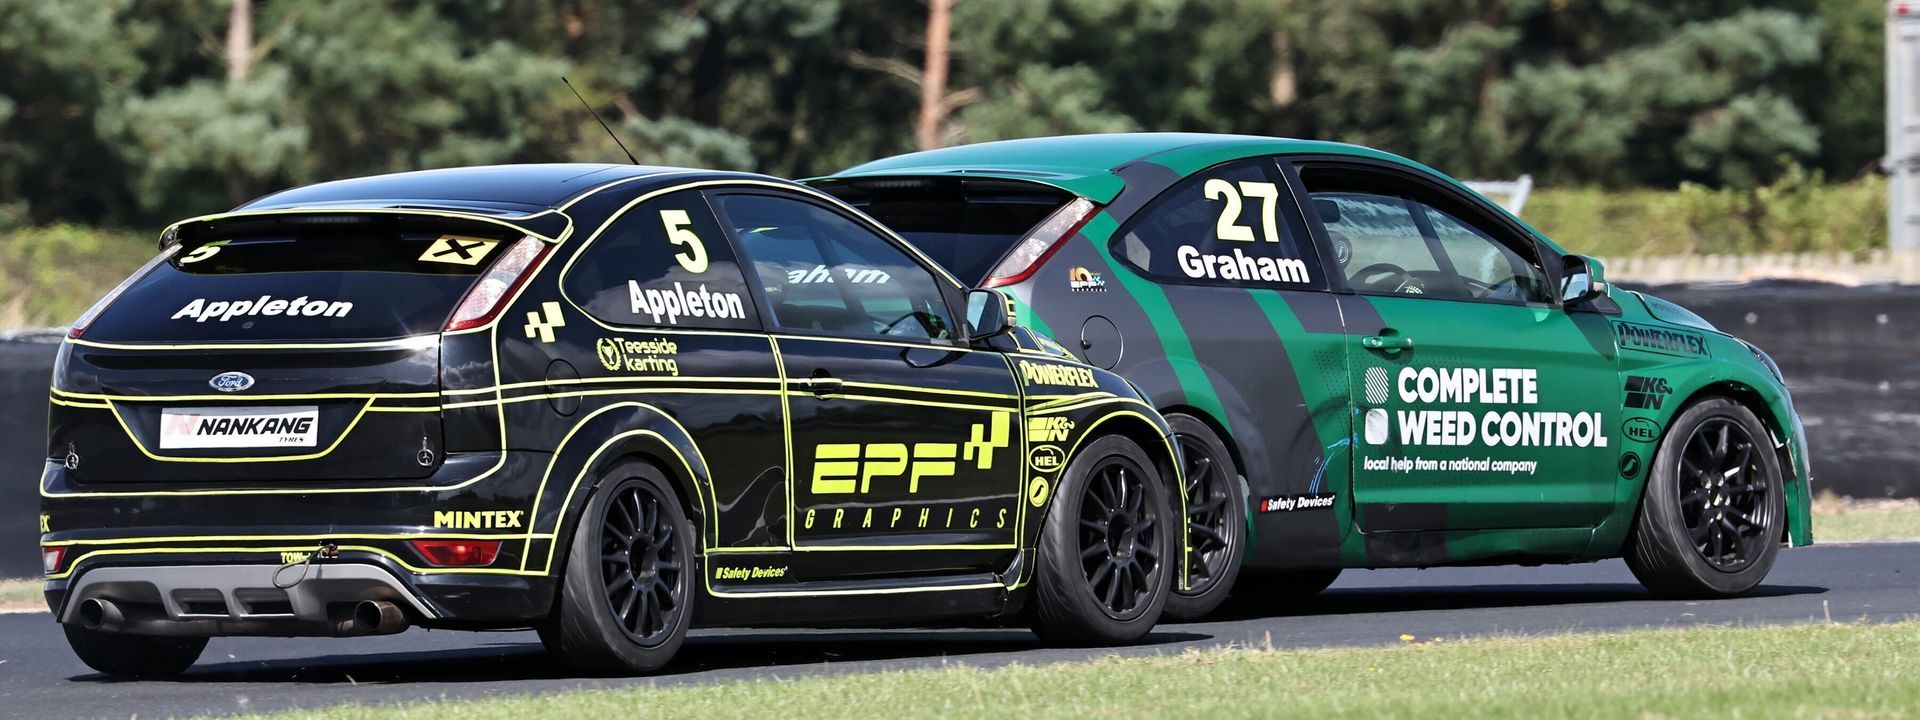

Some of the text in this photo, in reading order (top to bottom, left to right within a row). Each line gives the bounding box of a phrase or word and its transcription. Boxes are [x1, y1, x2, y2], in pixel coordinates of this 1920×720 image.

[1203, 178, 1280, 243] 27
[659, 209, 709, 274] 5
[1176, 244, 1310, 284] Graham
[171, 295, 353, 323] Appleton
[628, 279, 746, 325] Appleton
[613, 337, 678, 355] Teesside
[1617, 321, 1708, 356] POWERFLEX
[623, 353, 679, 377] karting
[1019, 359, 1100, 389] POWERFLEX
[218, 374, 244, 388] Ford
[1397, 366, 1539, 405] COMPLETE
[1641, 375, 1673, 411] K&N
[196, 417, 314, 436] NANKANG
[1045, 416, 1075, 442] K&N
[1397, 410, 1608, 448] WEED CONTROL
[1628, 426, 1656, 439] HEL
[810, 443, 958, 494] EPF
[1034, 455, 1060, 467] HEL
[1363, 456, 1538, 475] local help from a national company
[1267, 495, 1333, 512] Safety Devices
[434, 510, 522, 529] MINTEX
[804, 507, 1008, 530] GRAPHICS
[281, 552, 304, 564] TOW
[722, 566, 785, 581] Safety Devices
